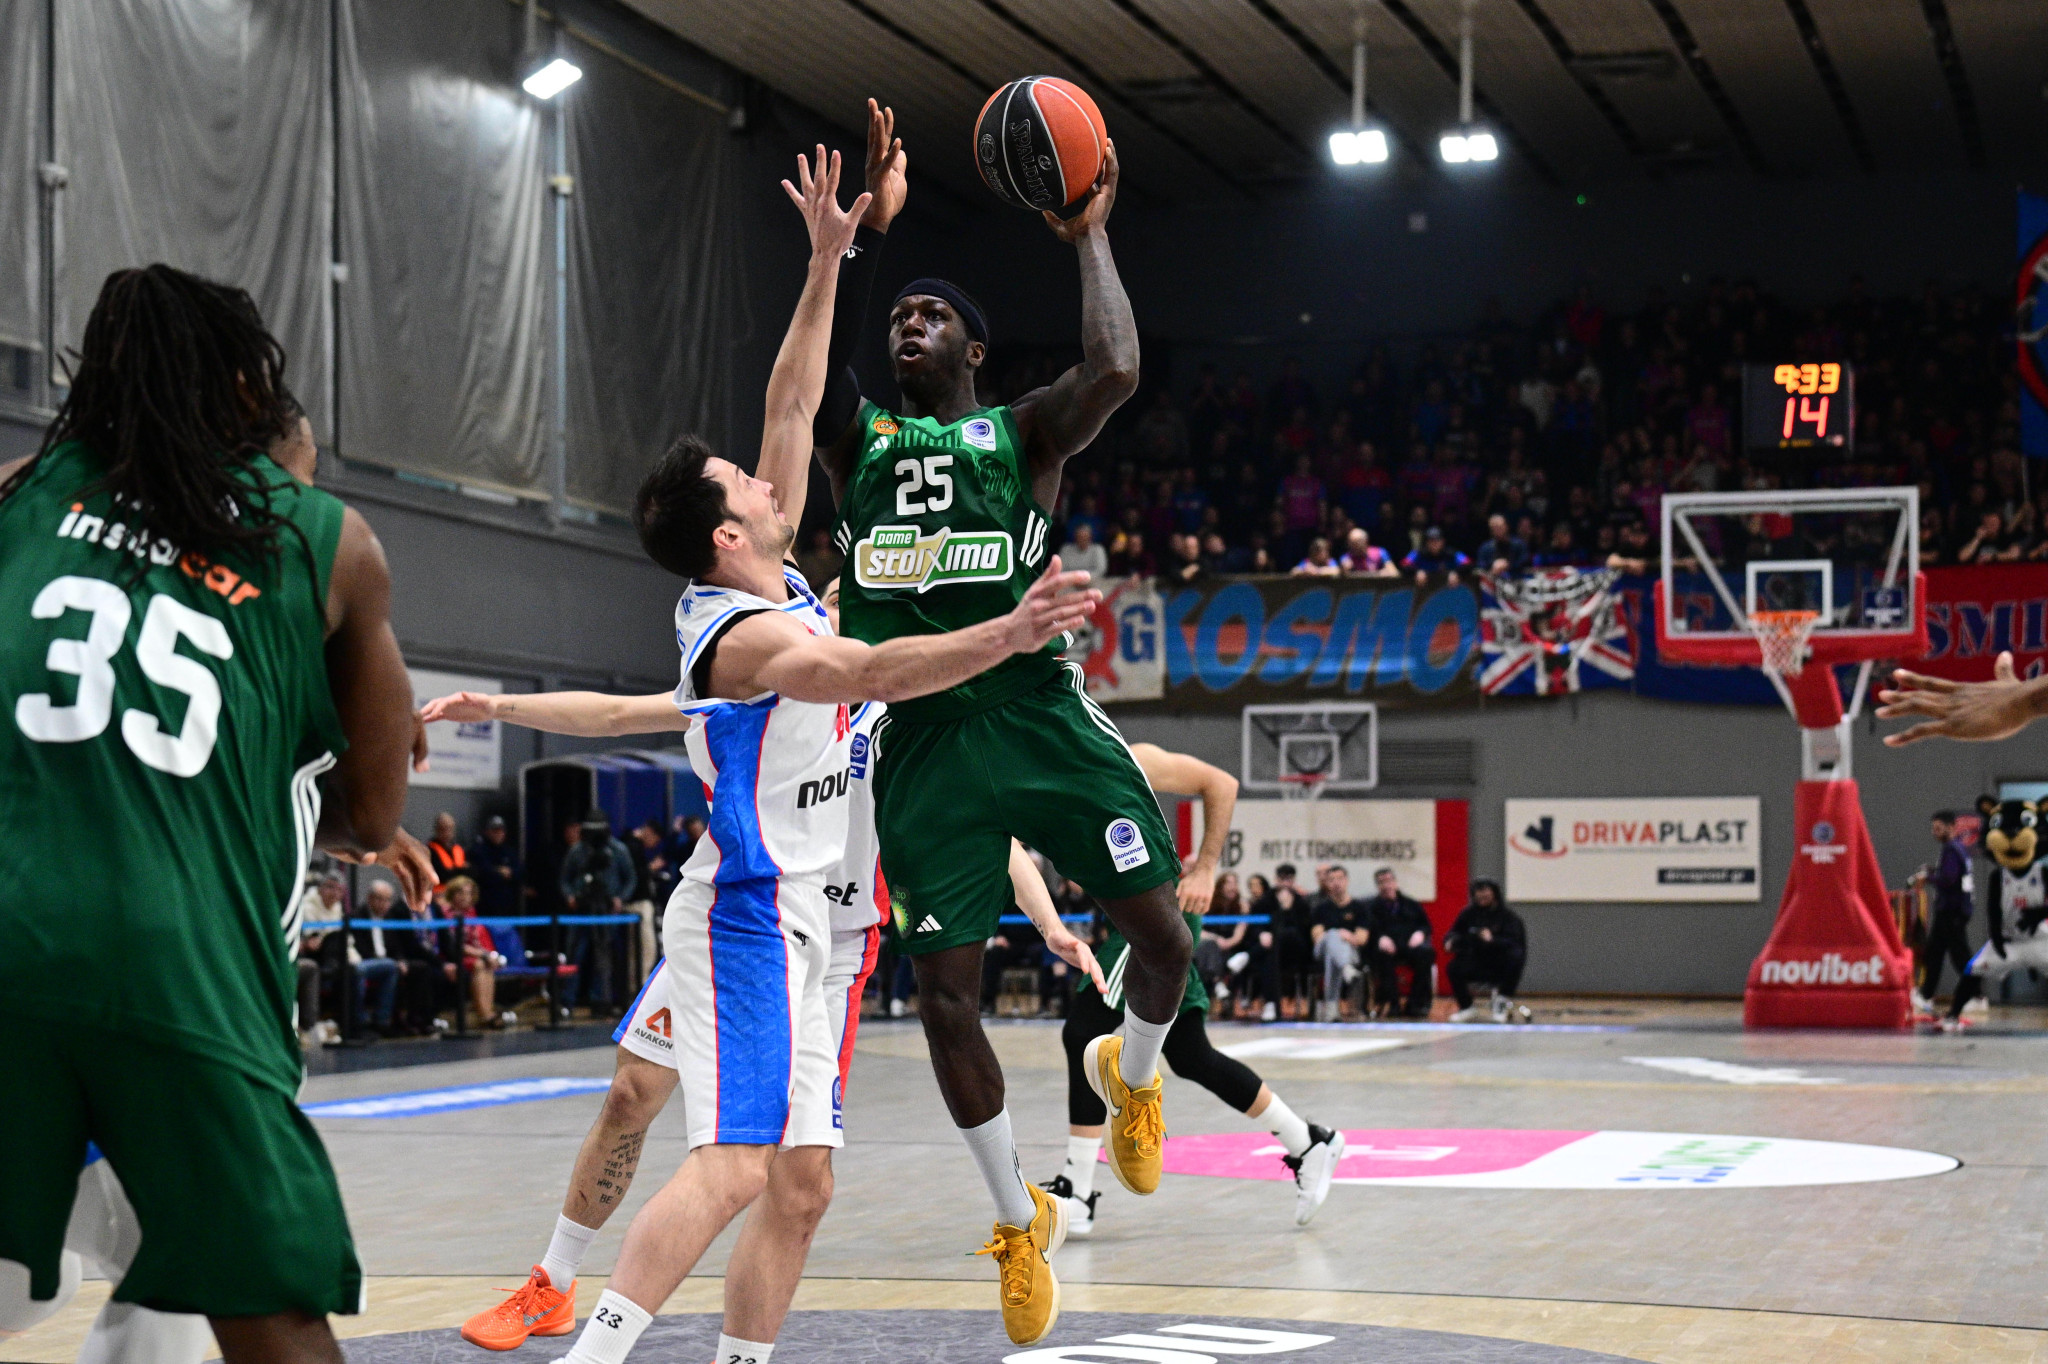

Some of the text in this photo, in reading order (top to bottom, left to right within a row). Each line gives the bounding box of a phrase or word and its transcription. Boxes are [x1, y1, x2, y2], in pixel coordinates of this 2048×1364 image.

[1774, 362, 1841, 395] 9:33
[1782, 395, 1830, 439] 14
[894, 454, 953, 516] 25
[876, 532, 912, 546] pame
[15, 575, 235, 778] 35
[797, 766, 851, 809] nov
[1572, 820, 1748, 844] DRIVAPLAST
[1124, 856, 1140, 866] GBL
[823, 882, 858, 906] et
[1761, 952, 1884, 985] novibet
[634, 1027, 674, 1051] AVAKON
[604, 1168, 623, 1178] TOLD
[606, 1160, 624, 1169] THEY
[599, 1193, 614, 1204] BE
[595, 1307, 623, 1330] 23
